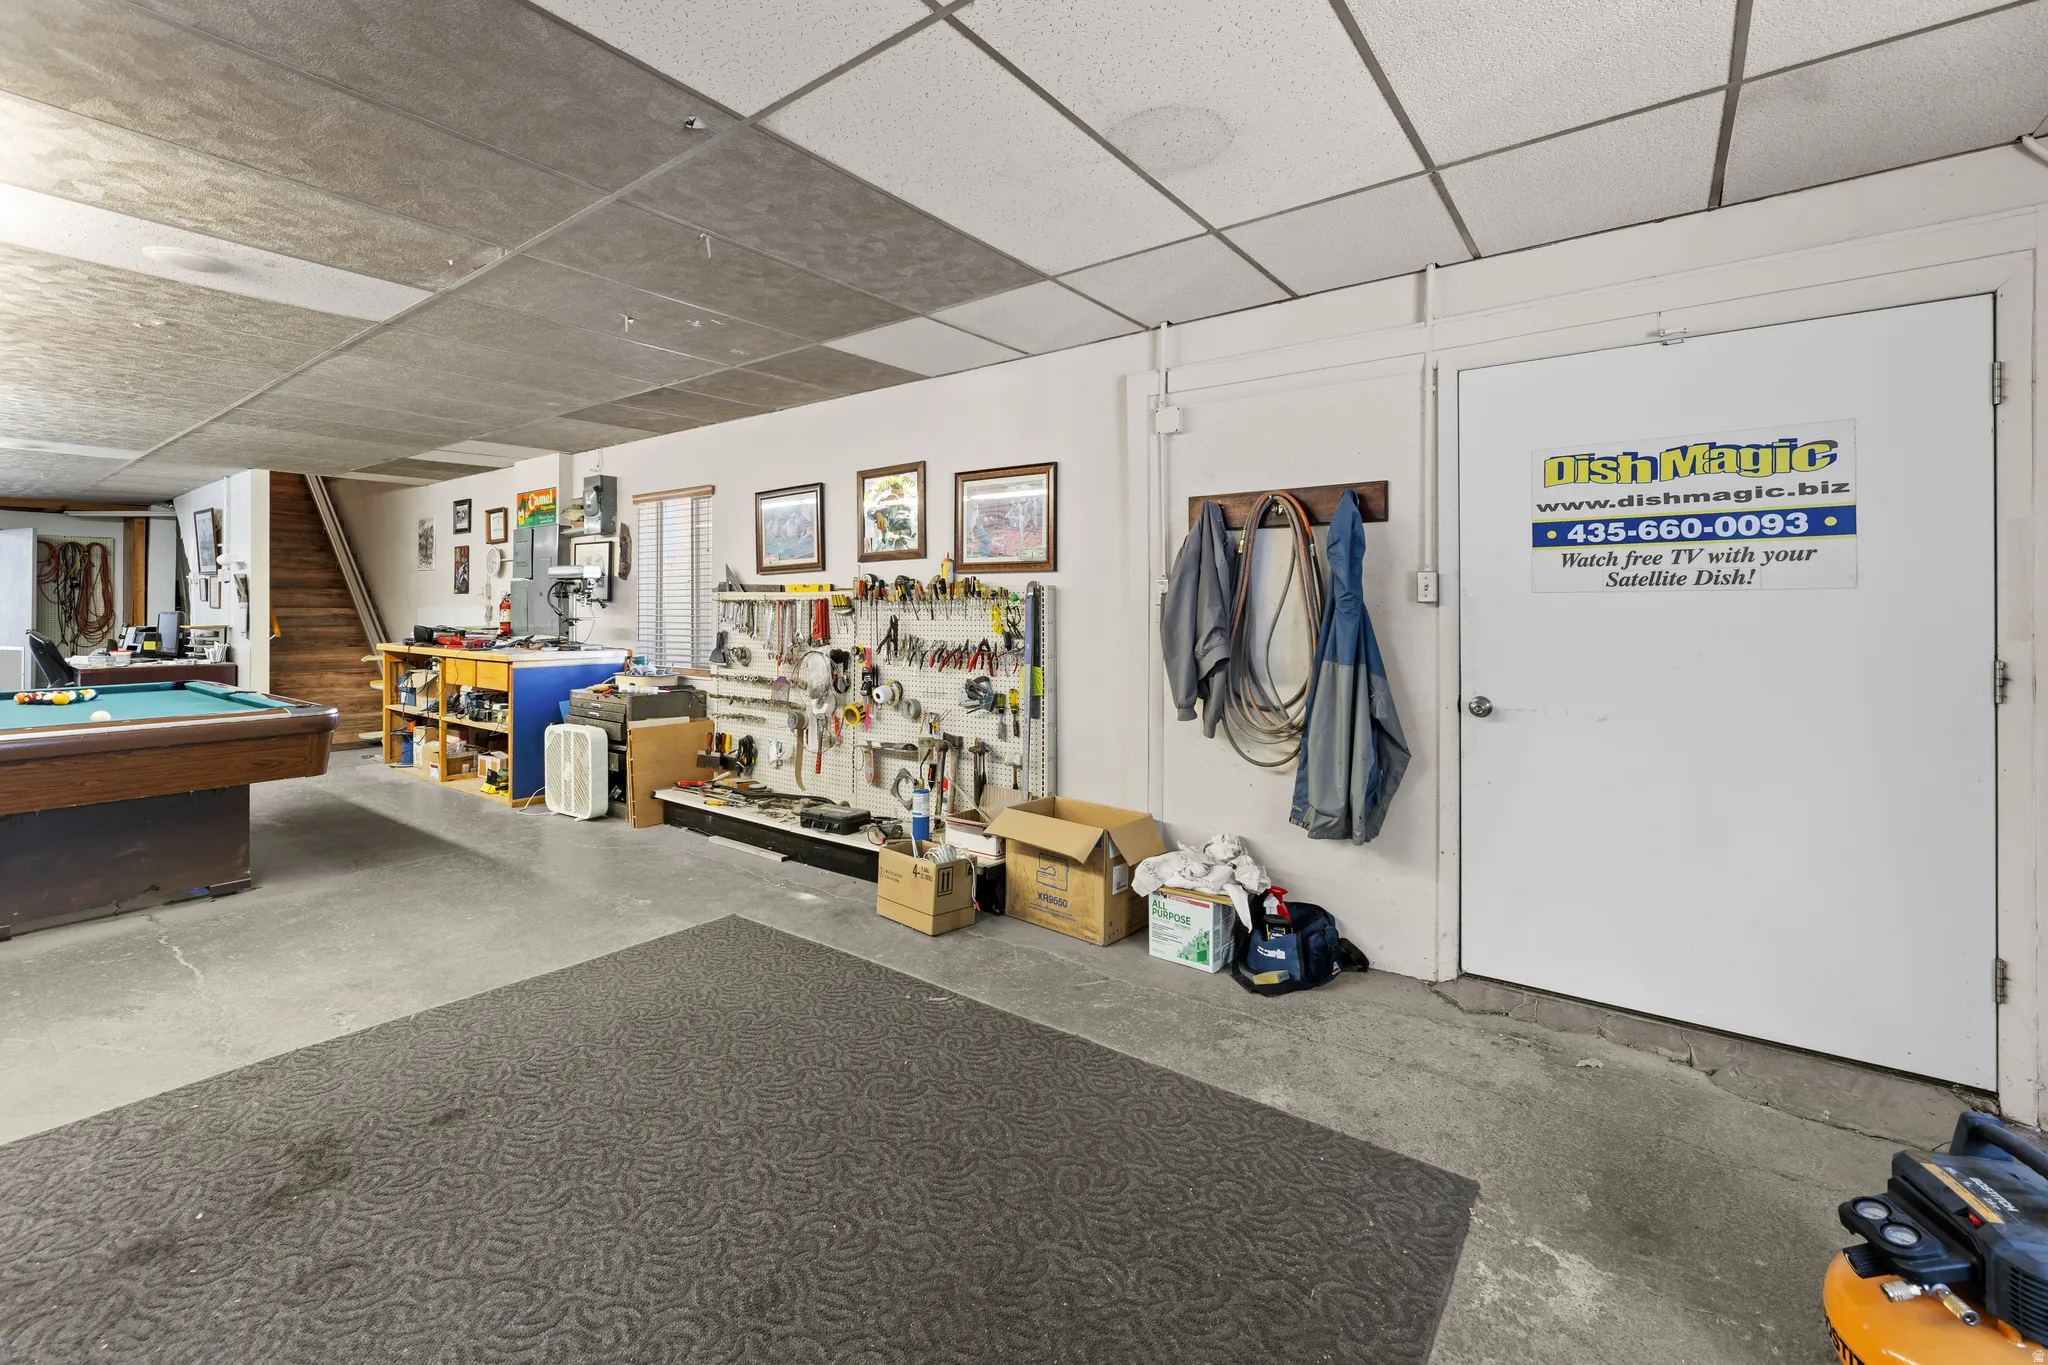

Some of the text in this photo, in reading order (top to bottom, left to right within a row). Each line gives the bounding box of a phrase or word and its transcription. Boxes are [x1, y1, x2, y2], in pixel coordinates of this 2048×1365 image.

[1660, 437, 1839, 482] Magic
[528, 489, 554, 510] Camel
[1536, 481, 1851, 512] www.dishmagic.biz
[1567, 512, 1809, 543] 435-660-0093
[1560, 546, 1818, 570] Watch free TV with your
[1605, 568, 1757, 588] Satellite Dish!
[1037, 892, 1068, 908] XR9550
[1152, 900, 1168, 911] ALL
[1152, 908, 1192, 926] PURPOSE
